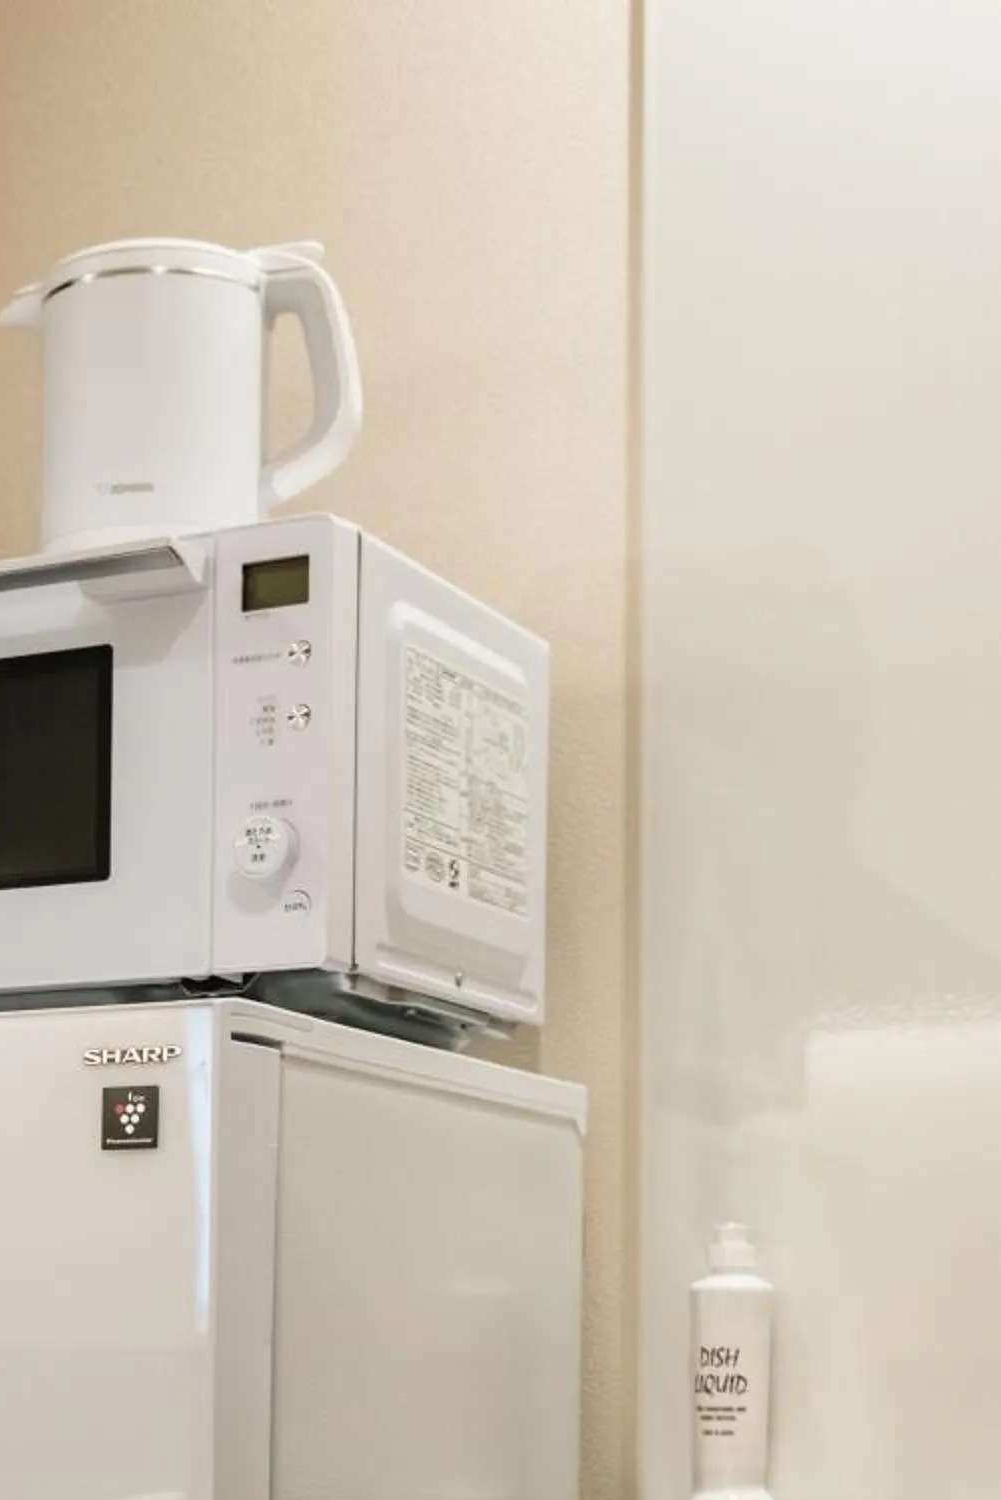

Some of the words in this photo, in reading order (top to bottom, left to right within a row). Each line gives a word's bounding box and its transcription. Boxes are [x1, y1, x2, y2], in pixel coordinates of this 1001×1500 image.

[82, 1044, 183, 1067] SHARP
[700, 1346, 740, 1369] DISH
[694, 1373, 749, 1396] LIQUID
